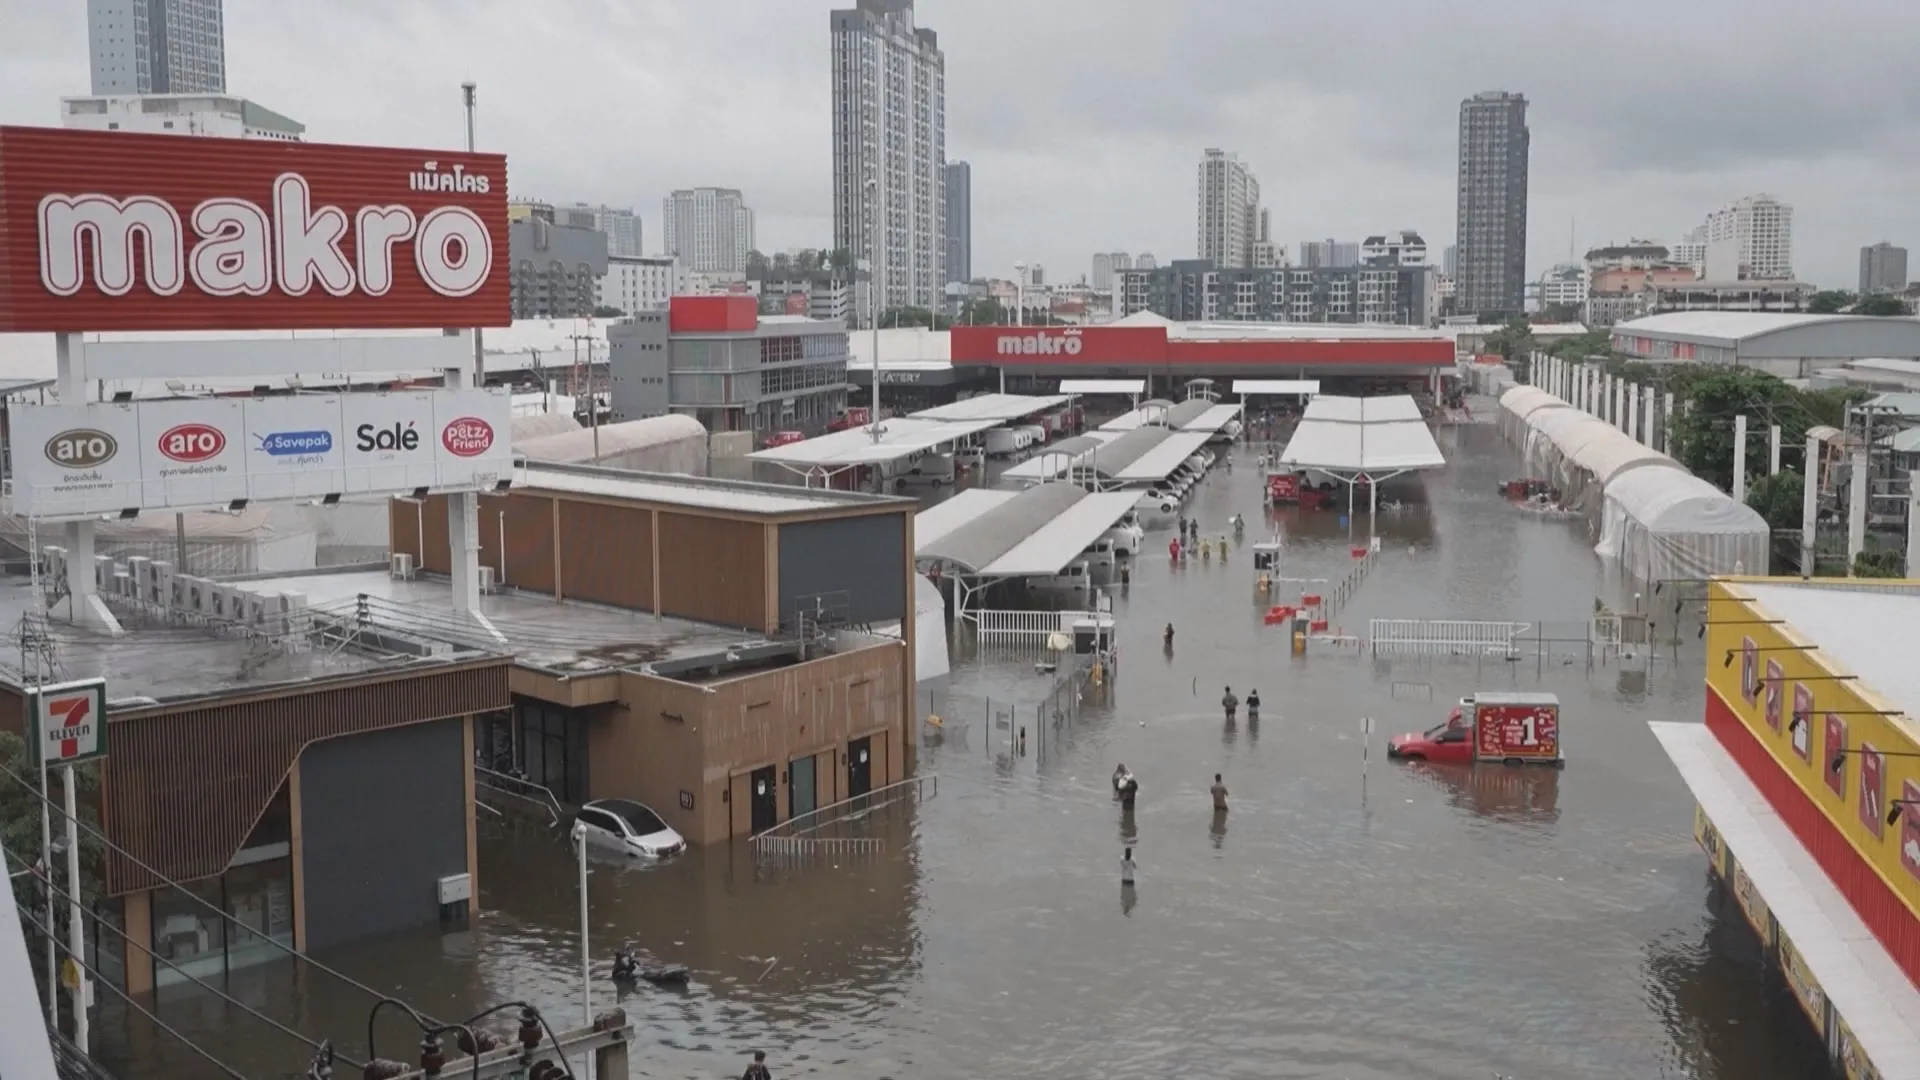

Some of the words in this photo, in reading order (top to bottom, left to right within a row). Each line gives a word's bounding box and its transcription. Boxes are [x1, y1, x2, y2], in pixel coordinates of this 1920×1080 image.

[409, 160, 490, 194] แม็คโคร
[37, 172, 493, 298] makro
[997, 331, 1082, 355] makro
[56, 437, 107, 460] aro
[169, 432, 216, 454] aro
[275, 433, 329, 449] Savepak
[356, 421, 419, 452] Solé
[453, 436, 489, 450] Friend
[49, 696, 90, 758] 7
[1521, 715, 1539, 746] 1
